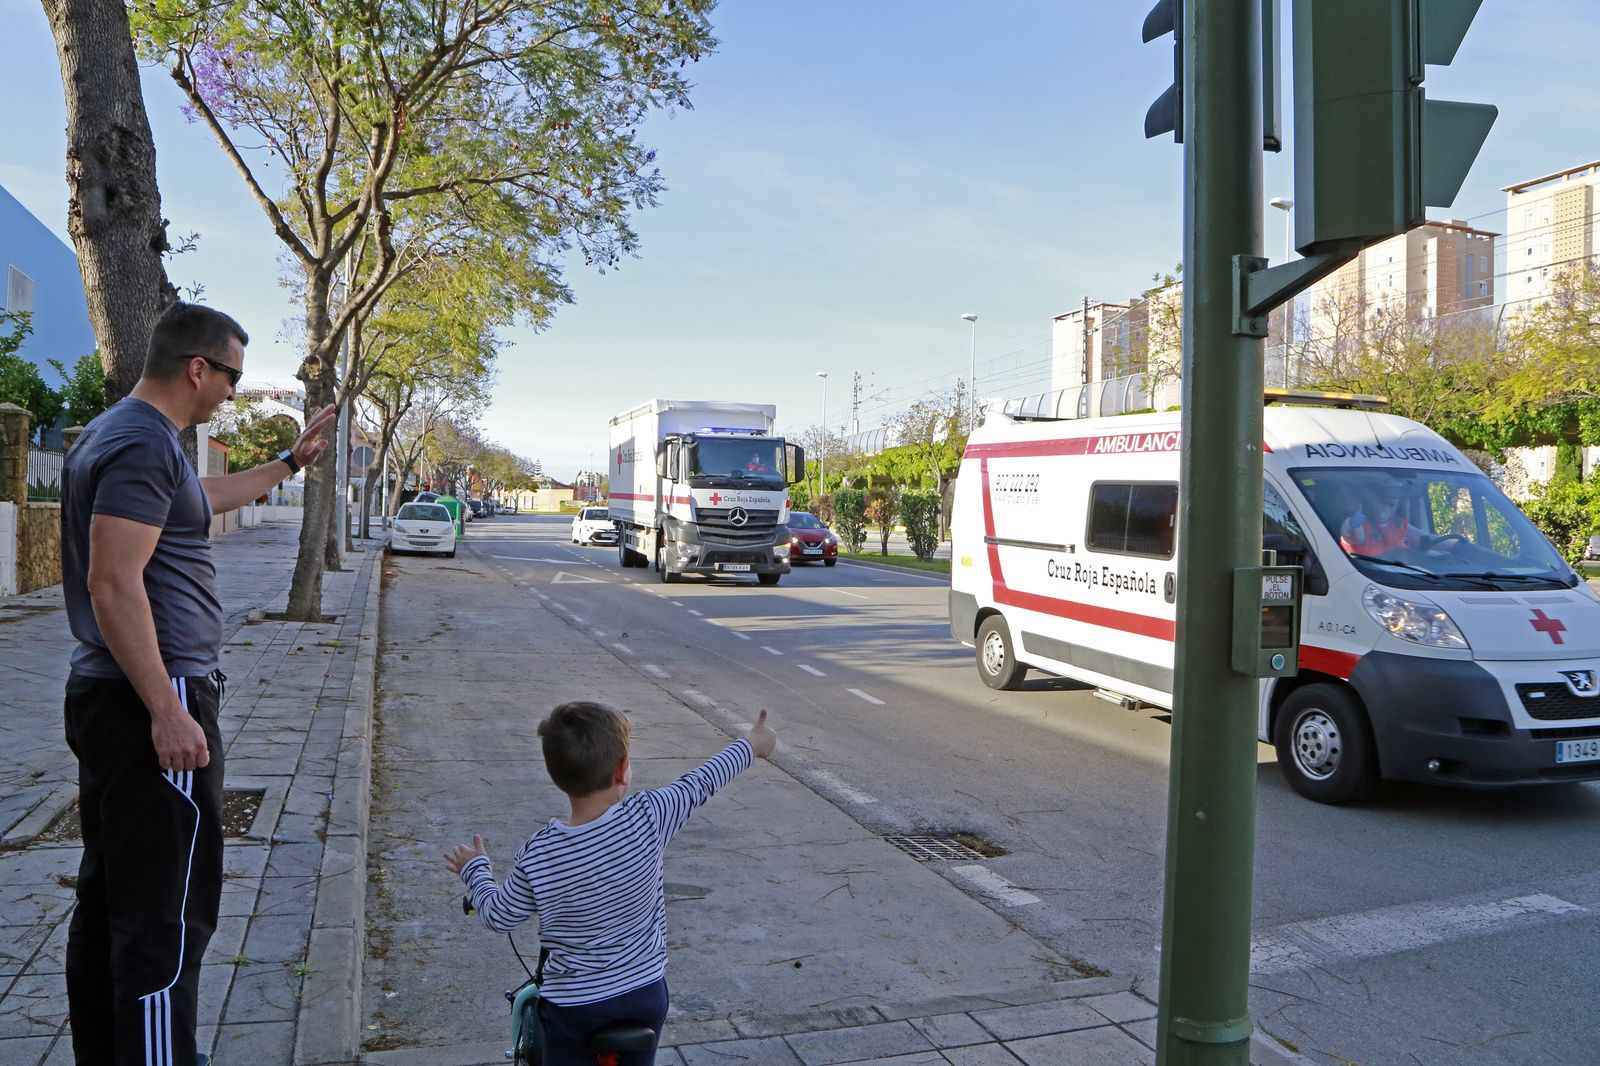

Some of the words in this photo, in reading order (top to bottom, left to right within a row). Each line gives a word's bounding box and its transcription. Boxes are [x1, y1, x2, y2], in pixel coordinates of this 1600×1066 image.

[1094, 432, 1181, 453] AMBULANCI
[1047, 558, 1072, 581] Cruz
[1074, 562, 1098, 590] Roja
[1101, 566, 1156, 595] Española
[1265, 575, 1288, 583] PULSE
[1567, 741, 1598, 759] 1349
